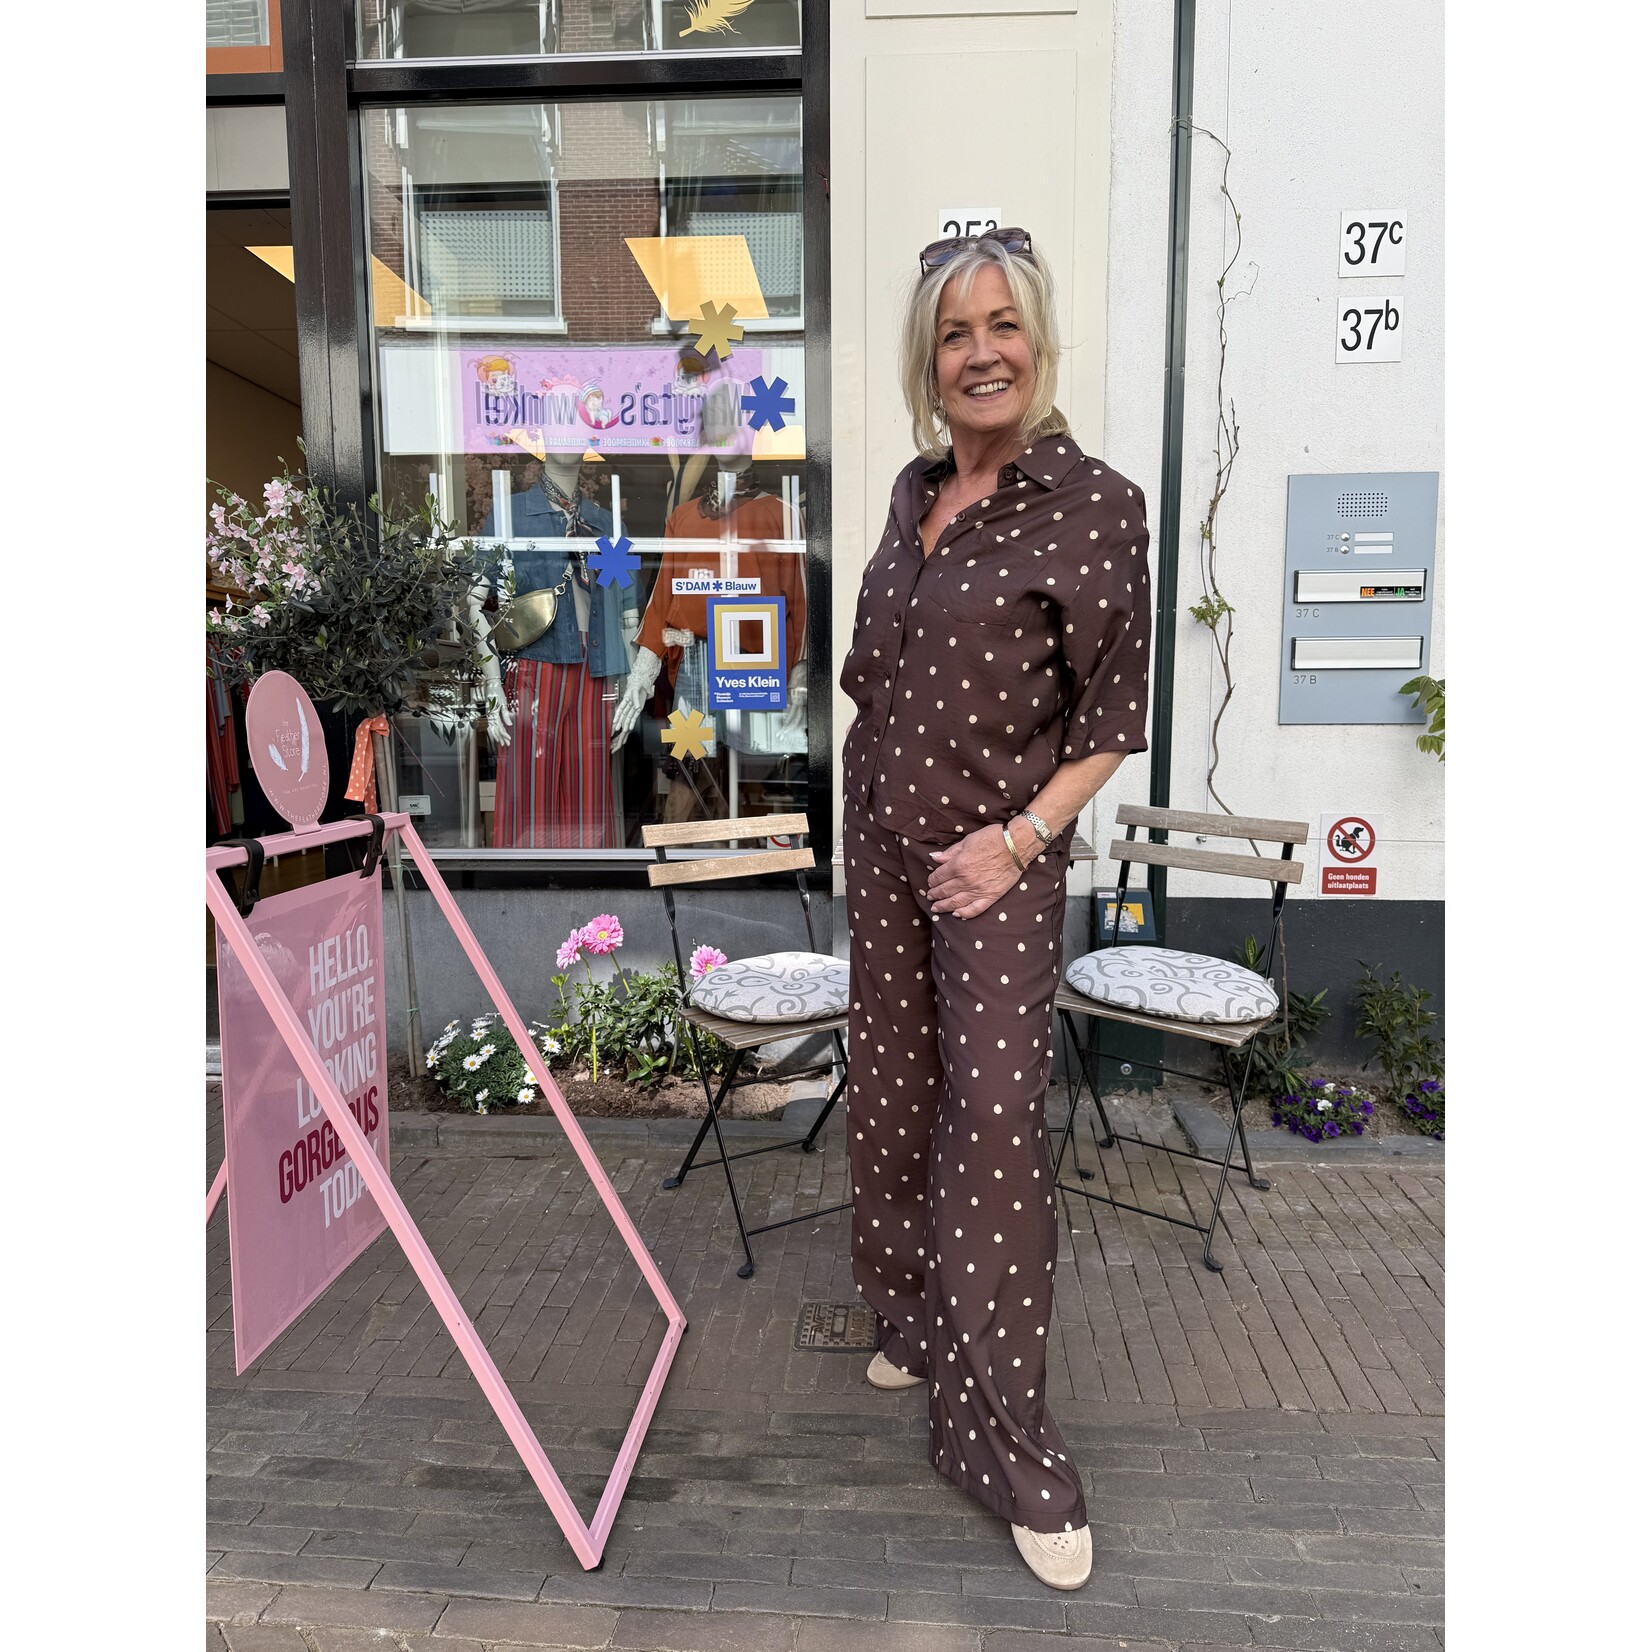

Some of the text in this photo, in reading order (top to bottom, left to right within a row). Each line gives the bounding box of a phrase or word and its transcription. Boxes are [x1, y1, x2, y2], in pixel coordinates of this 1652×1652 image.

[1344, 221, 1403, 265] 37c
[1341, 299, 1399, 351] 37b
[675, 581, 757, 591] S'DAM Blauw
[1361, 587, 1375, 597] NEE
[1396, 587, 1405, 597] JA
[1296, 608, 1320, 618] 37 C
[715, 676, 780, 688] Yves Klein
[1293, 674, 1317, 685] 37 B
[275, 729, 300, 743] Feather
[282, 744, 300, 758] Store
[1327, 882, 1369, 890] uitlaatplaats
[309, 924, 374, 997] HELLO.
[307, 976, 375, 1055] YOU'RE
